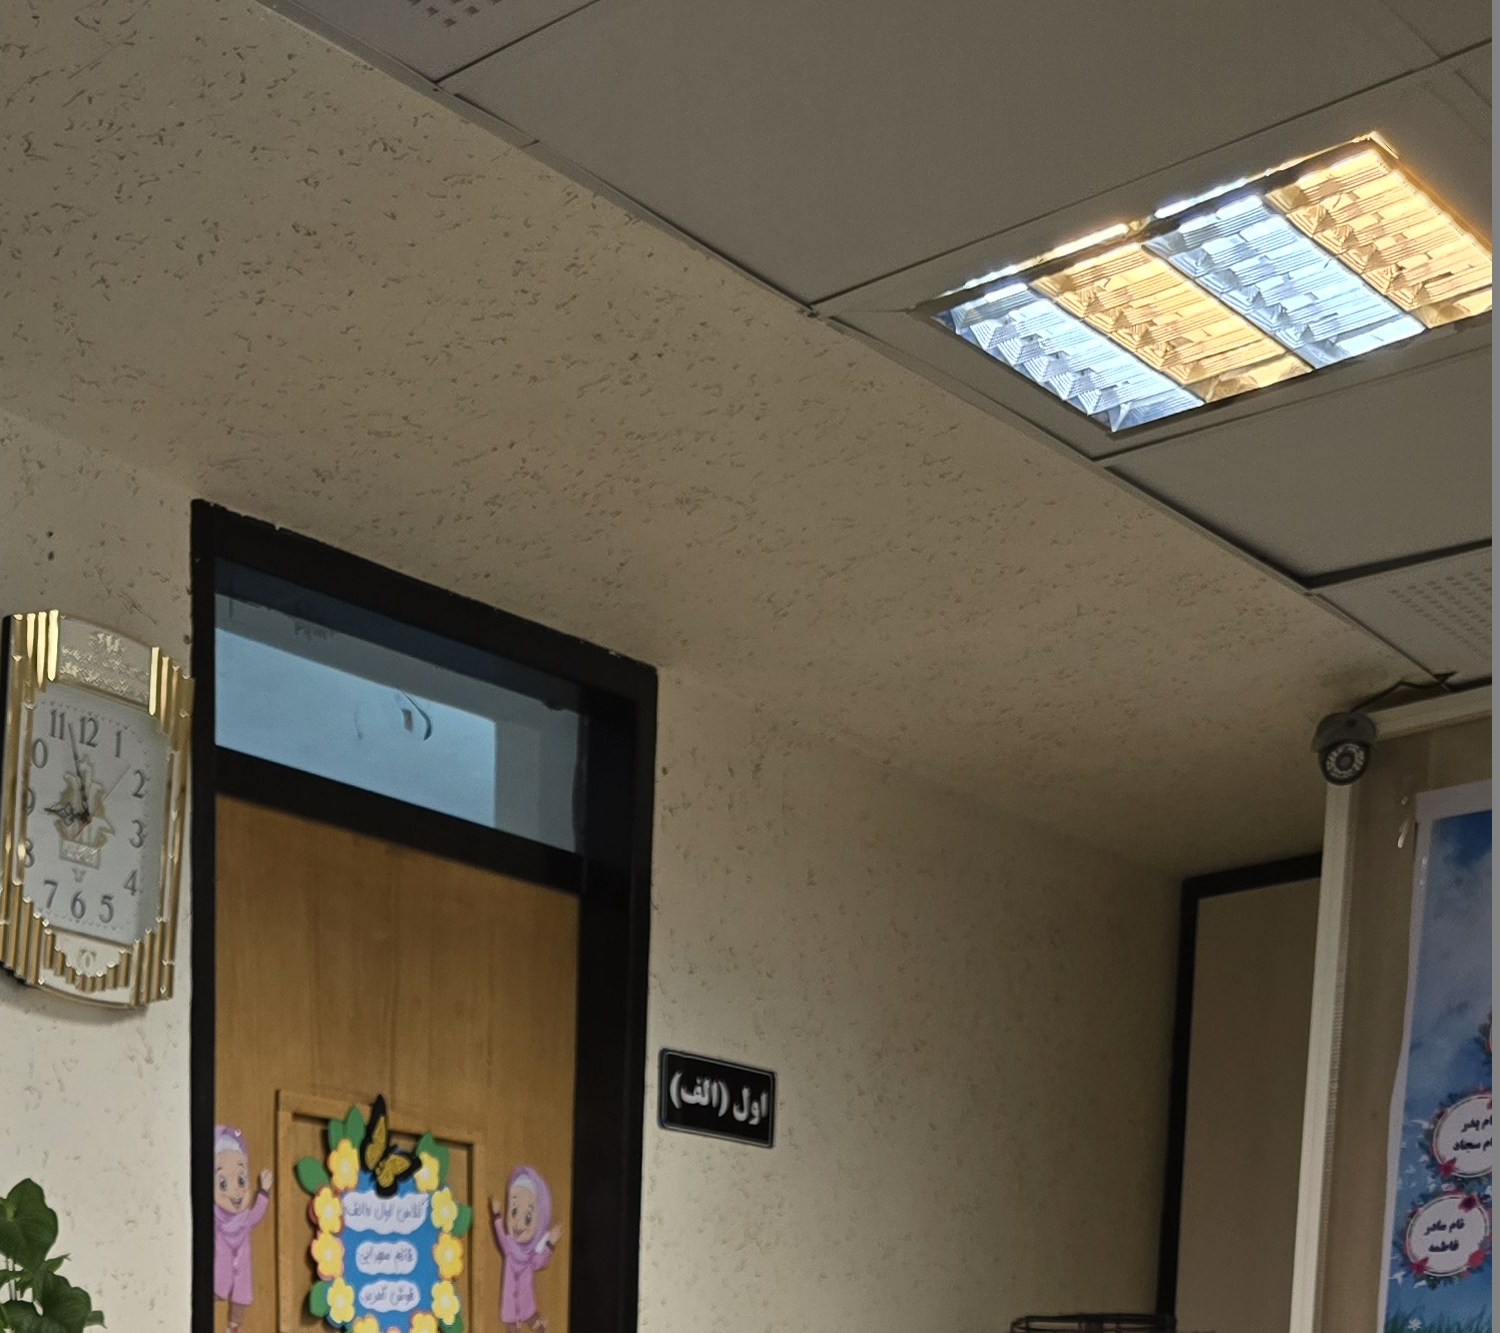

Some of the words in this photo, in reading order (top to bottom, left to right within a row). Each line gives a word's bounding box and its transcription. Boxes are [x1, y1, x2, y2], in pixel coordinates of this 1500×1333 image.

[50, 709, 65, 740] 11
[78, 715, 99, 748] 12
[32, 738, 48, 769] 0
[114, 729, 123, 759] 1
[132, 768, 147, 799] 2
[128, 819, 144, 849] 3
[43, 879, 59, 910] 7
[122, 869, 138, 897] 4
[70, 890, 87, 920] 6
[98, 894, 115, 924] 5
[670, 1071, 729, 1117] (الف)
[733, 1086, 768, 1125] اول
[1428, 1240, 1459, 1252] فاطمه
